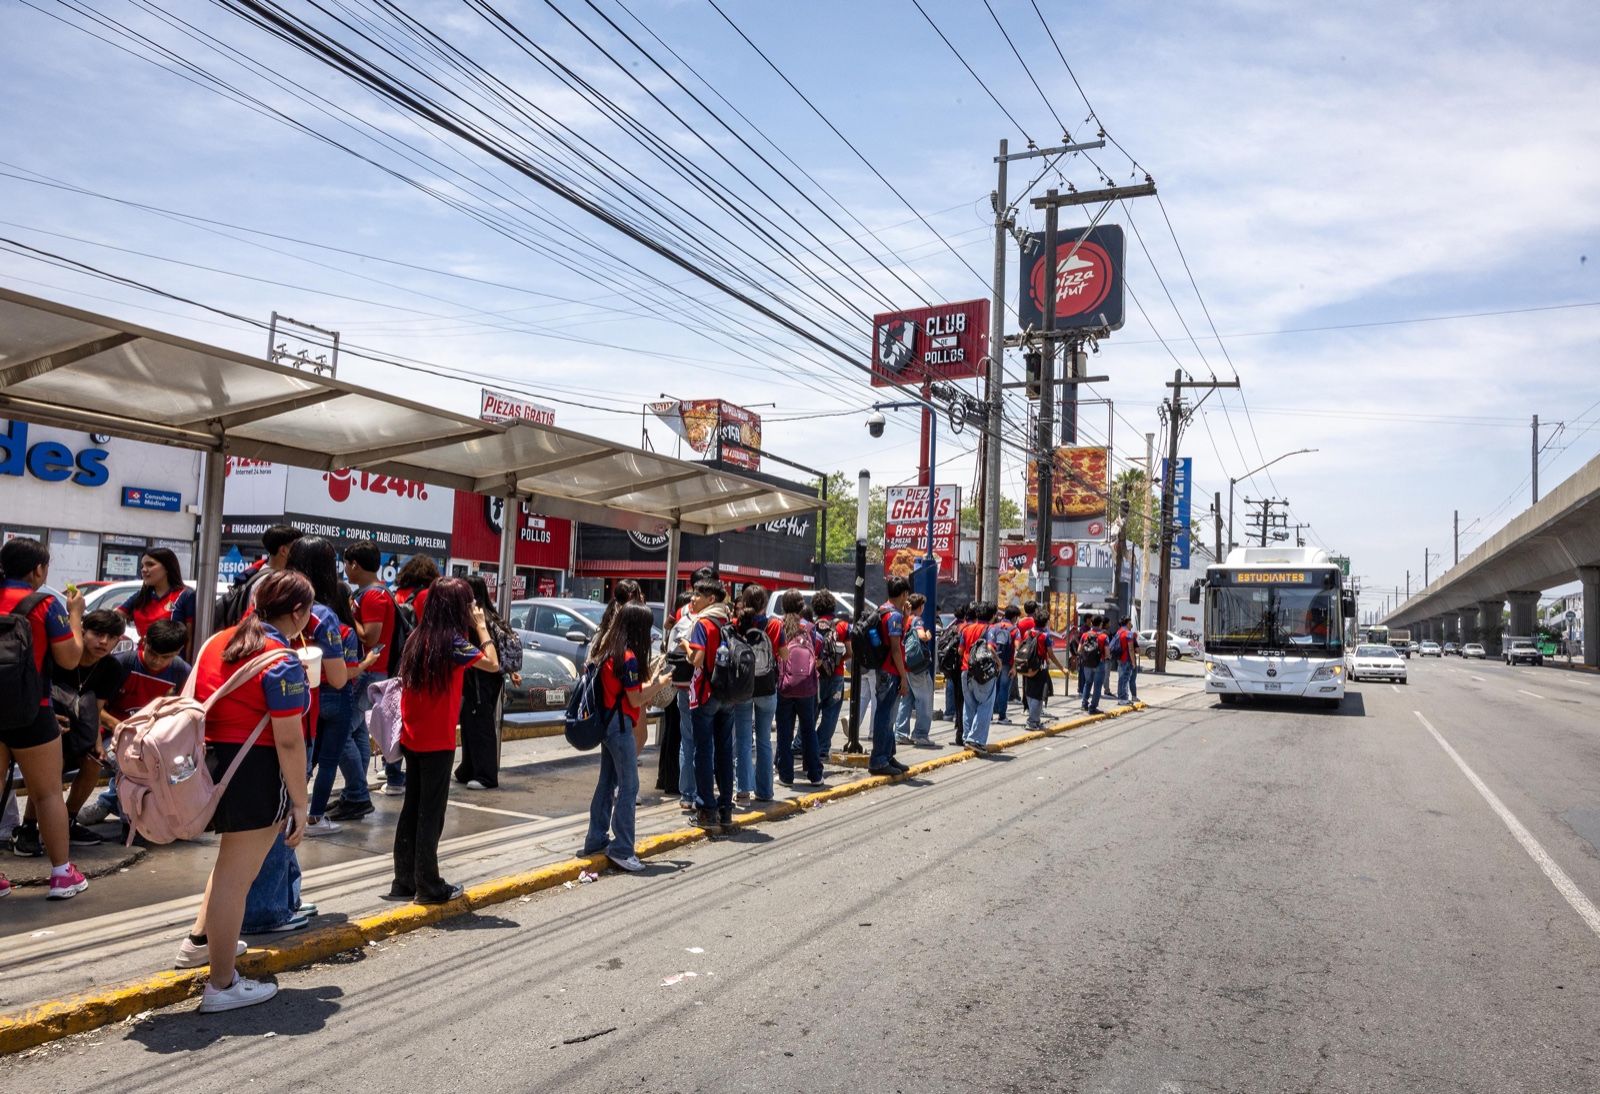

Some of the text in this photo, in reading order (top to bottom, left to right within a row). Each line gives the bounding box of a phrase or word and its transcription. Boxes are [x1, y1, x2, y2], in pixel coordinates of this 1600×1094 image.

[1056, 282, 1089, 302] Hut
[926, 313, 966, 336] CLUB
[924, 348, 964, 364] POLLOS
[484, 396, 555, 426] PIEZAS GRATIS
[144, 493, 178, 503] Consultorio
[906, 487, 941, 501] PIEZS
[786, 515, 810, 538] Hut
[291, 521, 447, 549] IMPRESIONES COPIAS TABLOIDES PAPELERIA
[521, 528, 551, 543] POLLOS
[651, 535, 667, 545] PAN
[1008, 554, 1027, 567] $119
[1237, 573, 1305, 583] ESTUDIANTES
